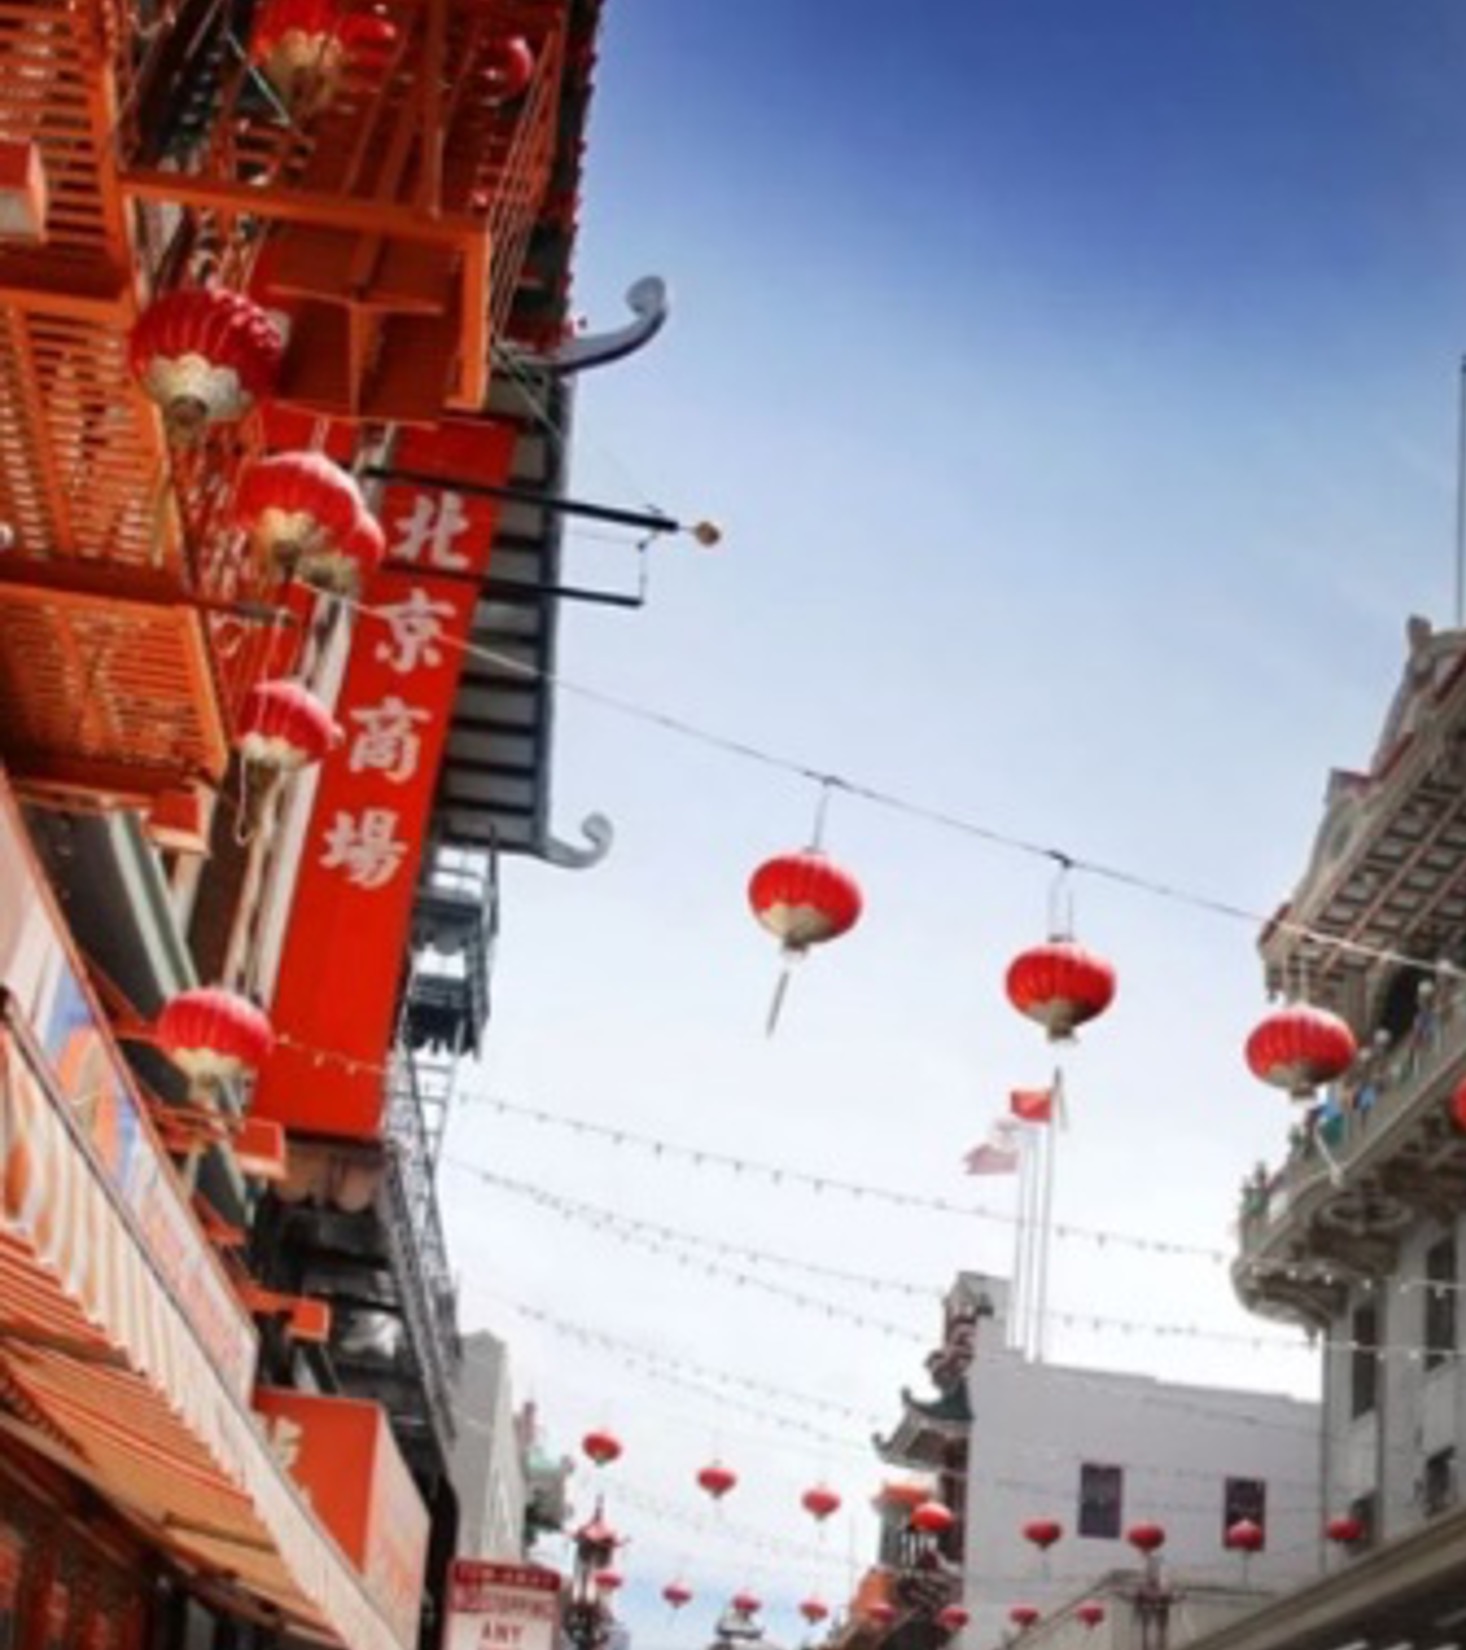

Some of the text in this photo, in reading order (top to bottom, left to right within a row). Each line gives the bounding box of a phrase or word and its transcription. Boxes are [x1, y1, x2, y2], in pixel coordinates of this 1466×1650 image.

[320, 490, 470, 889] 北京商場
[481, 1620, 523, 1644] ANY
